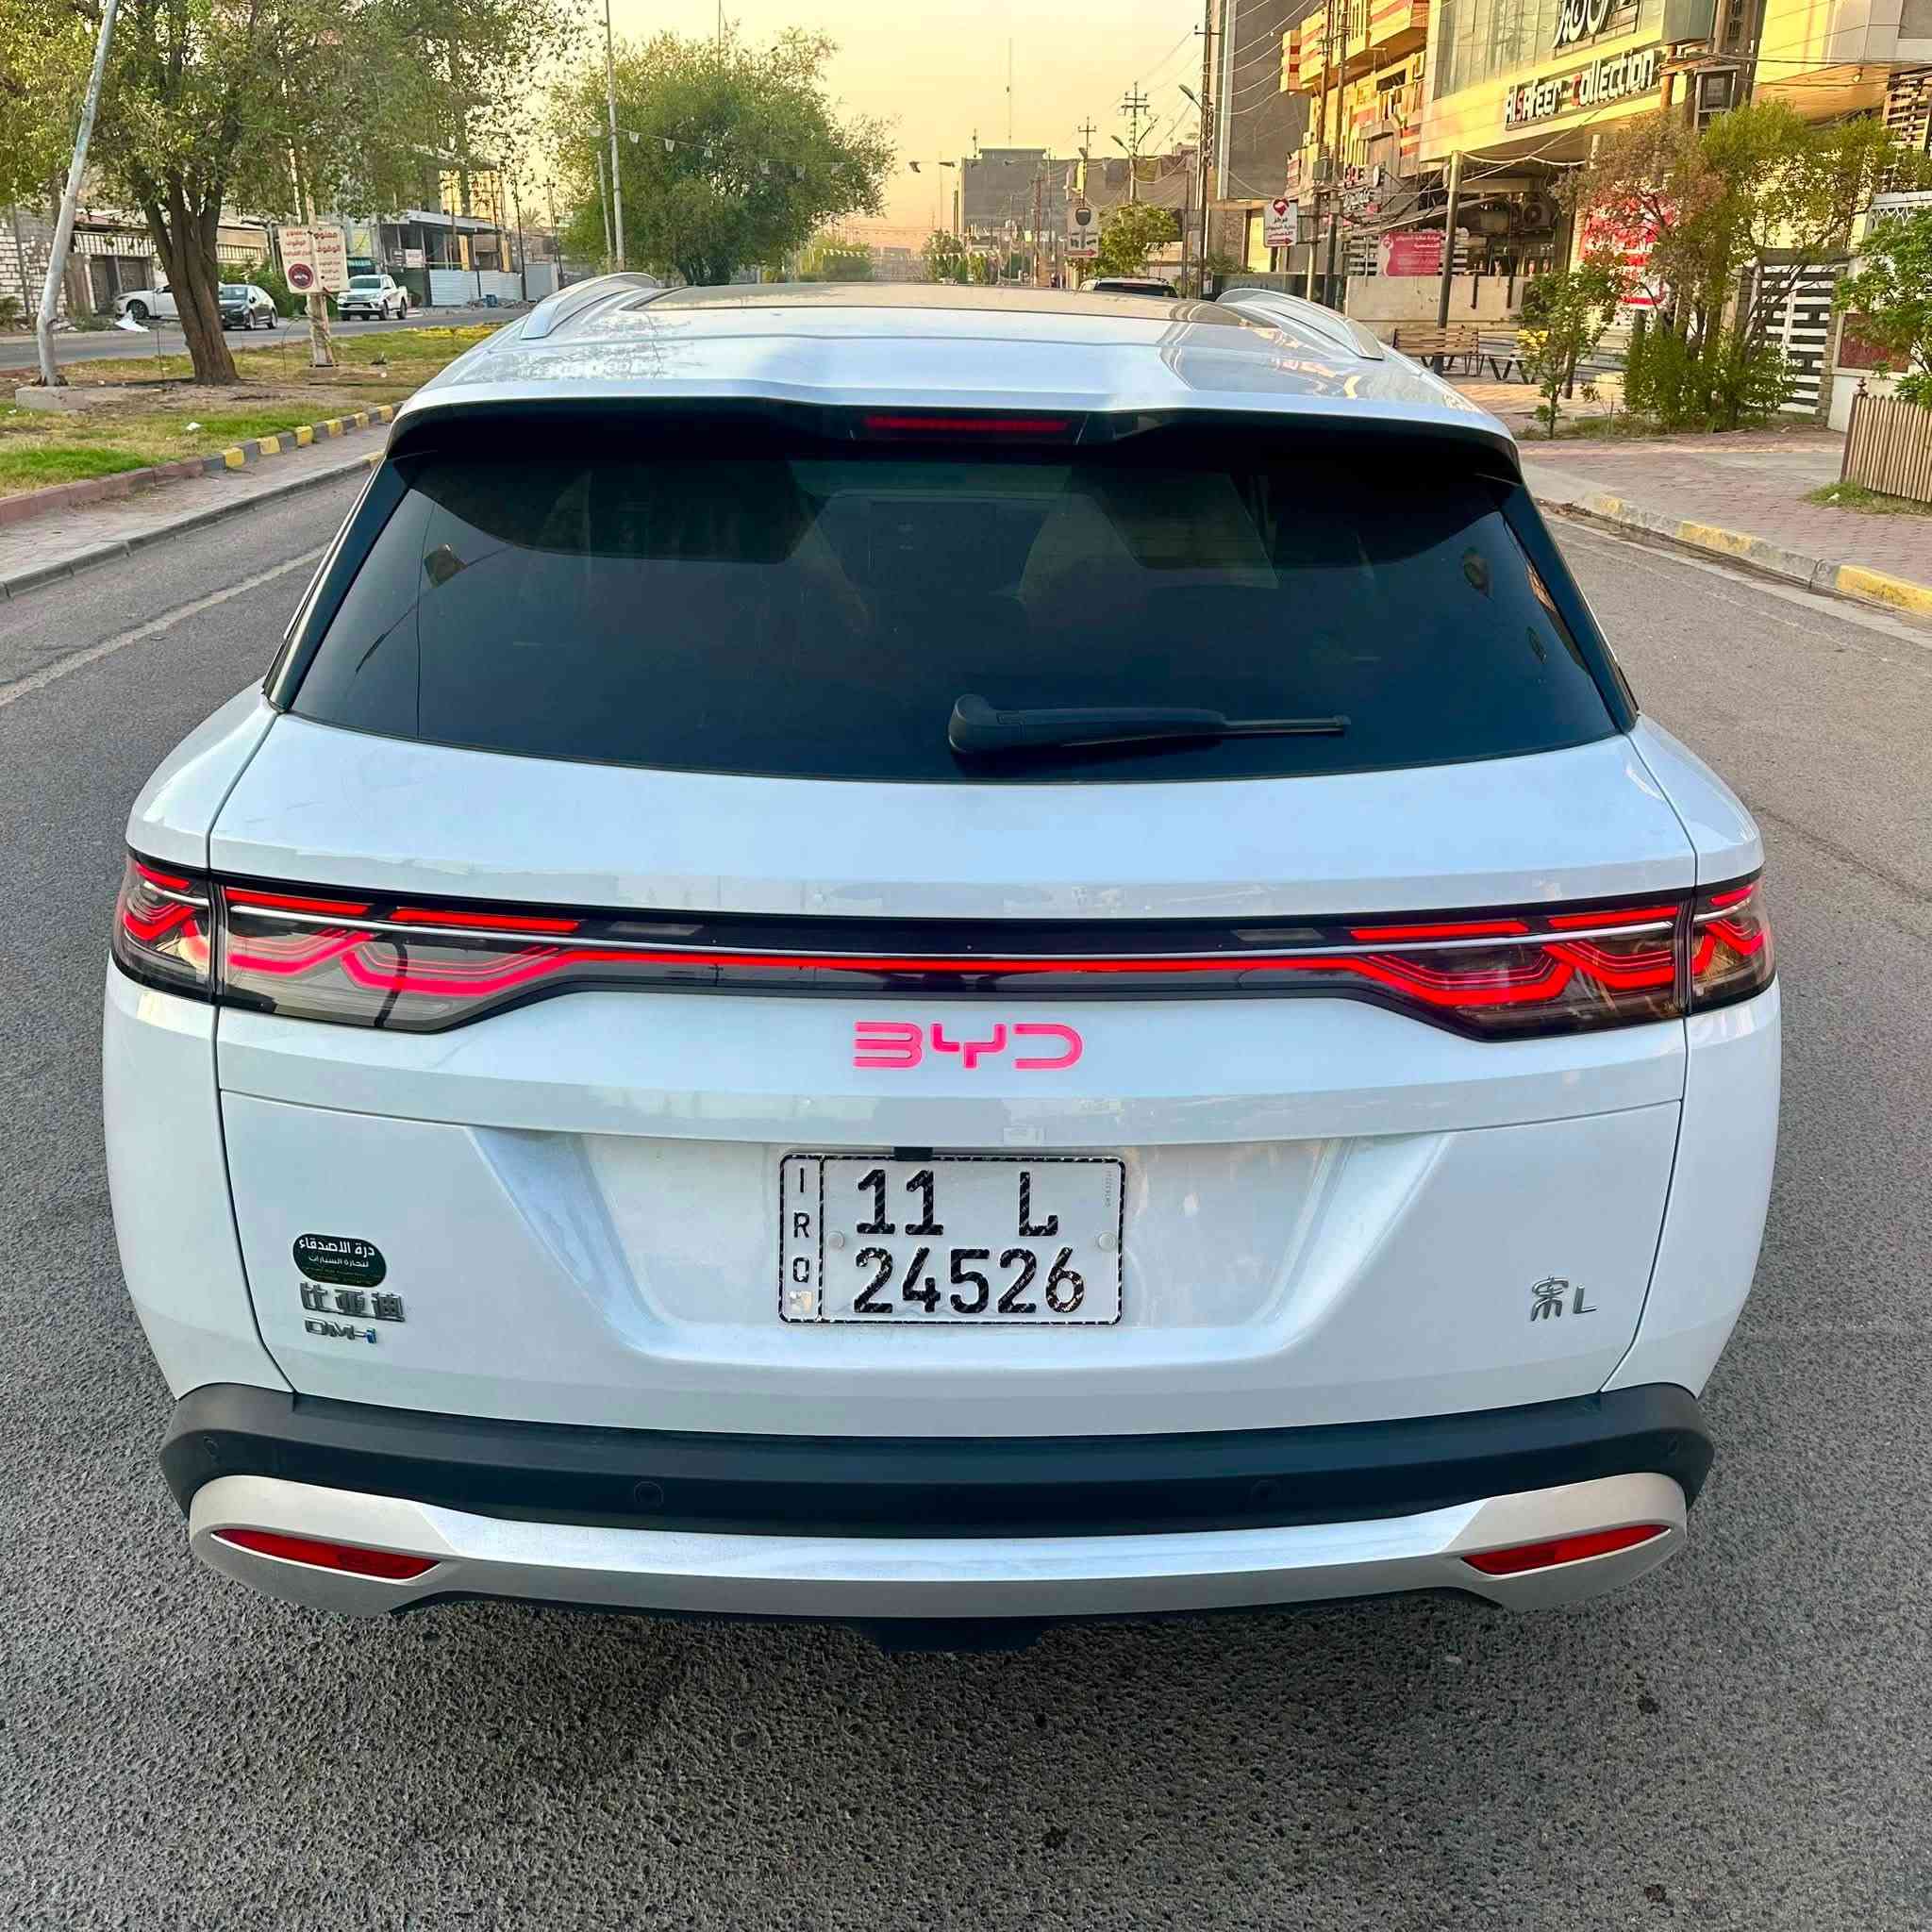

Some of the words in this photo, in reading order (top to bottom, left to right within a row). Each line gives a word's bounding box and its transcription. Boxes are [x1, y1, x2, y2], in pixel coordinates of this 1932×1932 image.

[853, 1020, 1084, 1071] BYD
[856, 1169, 944, 1236] 11
[1018, 1171, 1059, 1238] L
[355, 1242, 375, 1258] درة
[853, 1246, 1086, 1314] 24526
